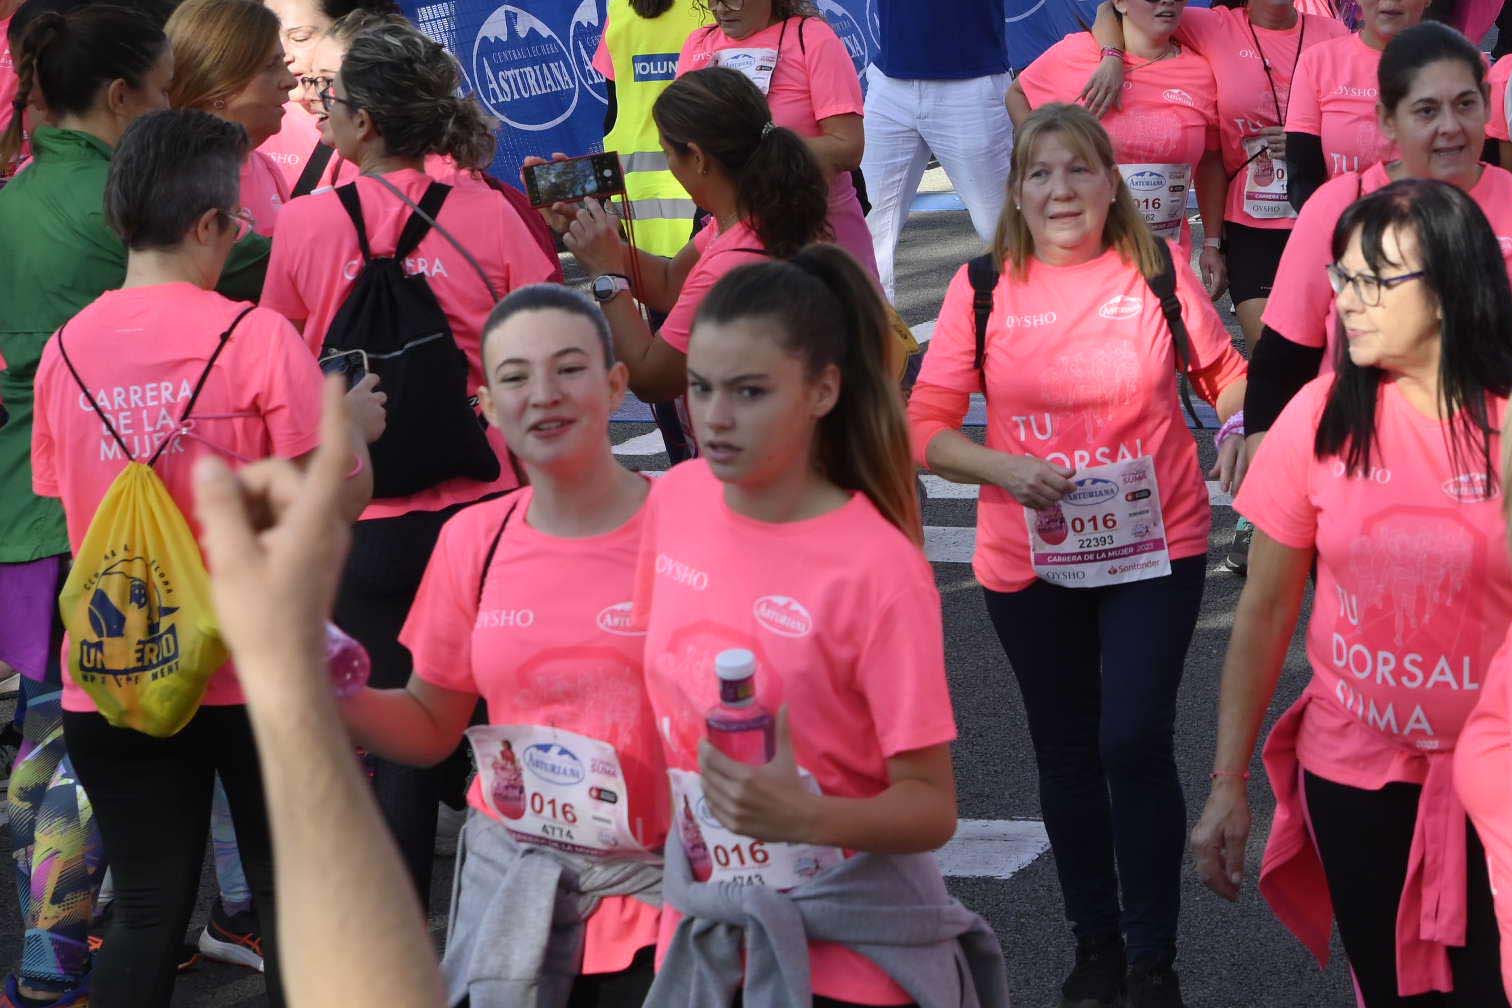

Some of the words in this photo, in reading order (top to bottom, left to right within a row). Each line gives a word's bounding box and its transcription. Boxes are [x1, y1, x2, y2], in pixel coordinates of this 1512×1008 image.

[483, 56, 574, 105] ASTURIANA
[270, 152, 300, 167] SHO
[1330, 153, 1359, 173] TU
[1252, 204, 1281, 213] OYSHO
[79, 378, 194, 413] CARRERA
[102, 410, 134, 437] DE
[142, 407, 176, 433] LA
[1012, 412, 1055, 442] TU
[1023, 438, 1144, 474] ORSAL
[1071, 512, 1118, 534] 016
[1047, 552, 1082, 563] CARRERA
[1083, 552, 1095, 561] DE
[1096, 551, 1107, 559] LA
[1078, 535, 1114, 549] 22393
[656, 553, 710, 592] OYSHO
[1046, 569, 1086, 581] OYSHO
[1118, 558, 1160, 573] Santander
[1336, 584, 1360, 626] TU
[1332, 632, 1480, 691] DORSAL
[1335, 679, 1435, 737] SUMA
[527, 755, 582, 779] ASTURIANA
[528, 791, 578, 825] 016
[713, 840, 770, 867] 016
